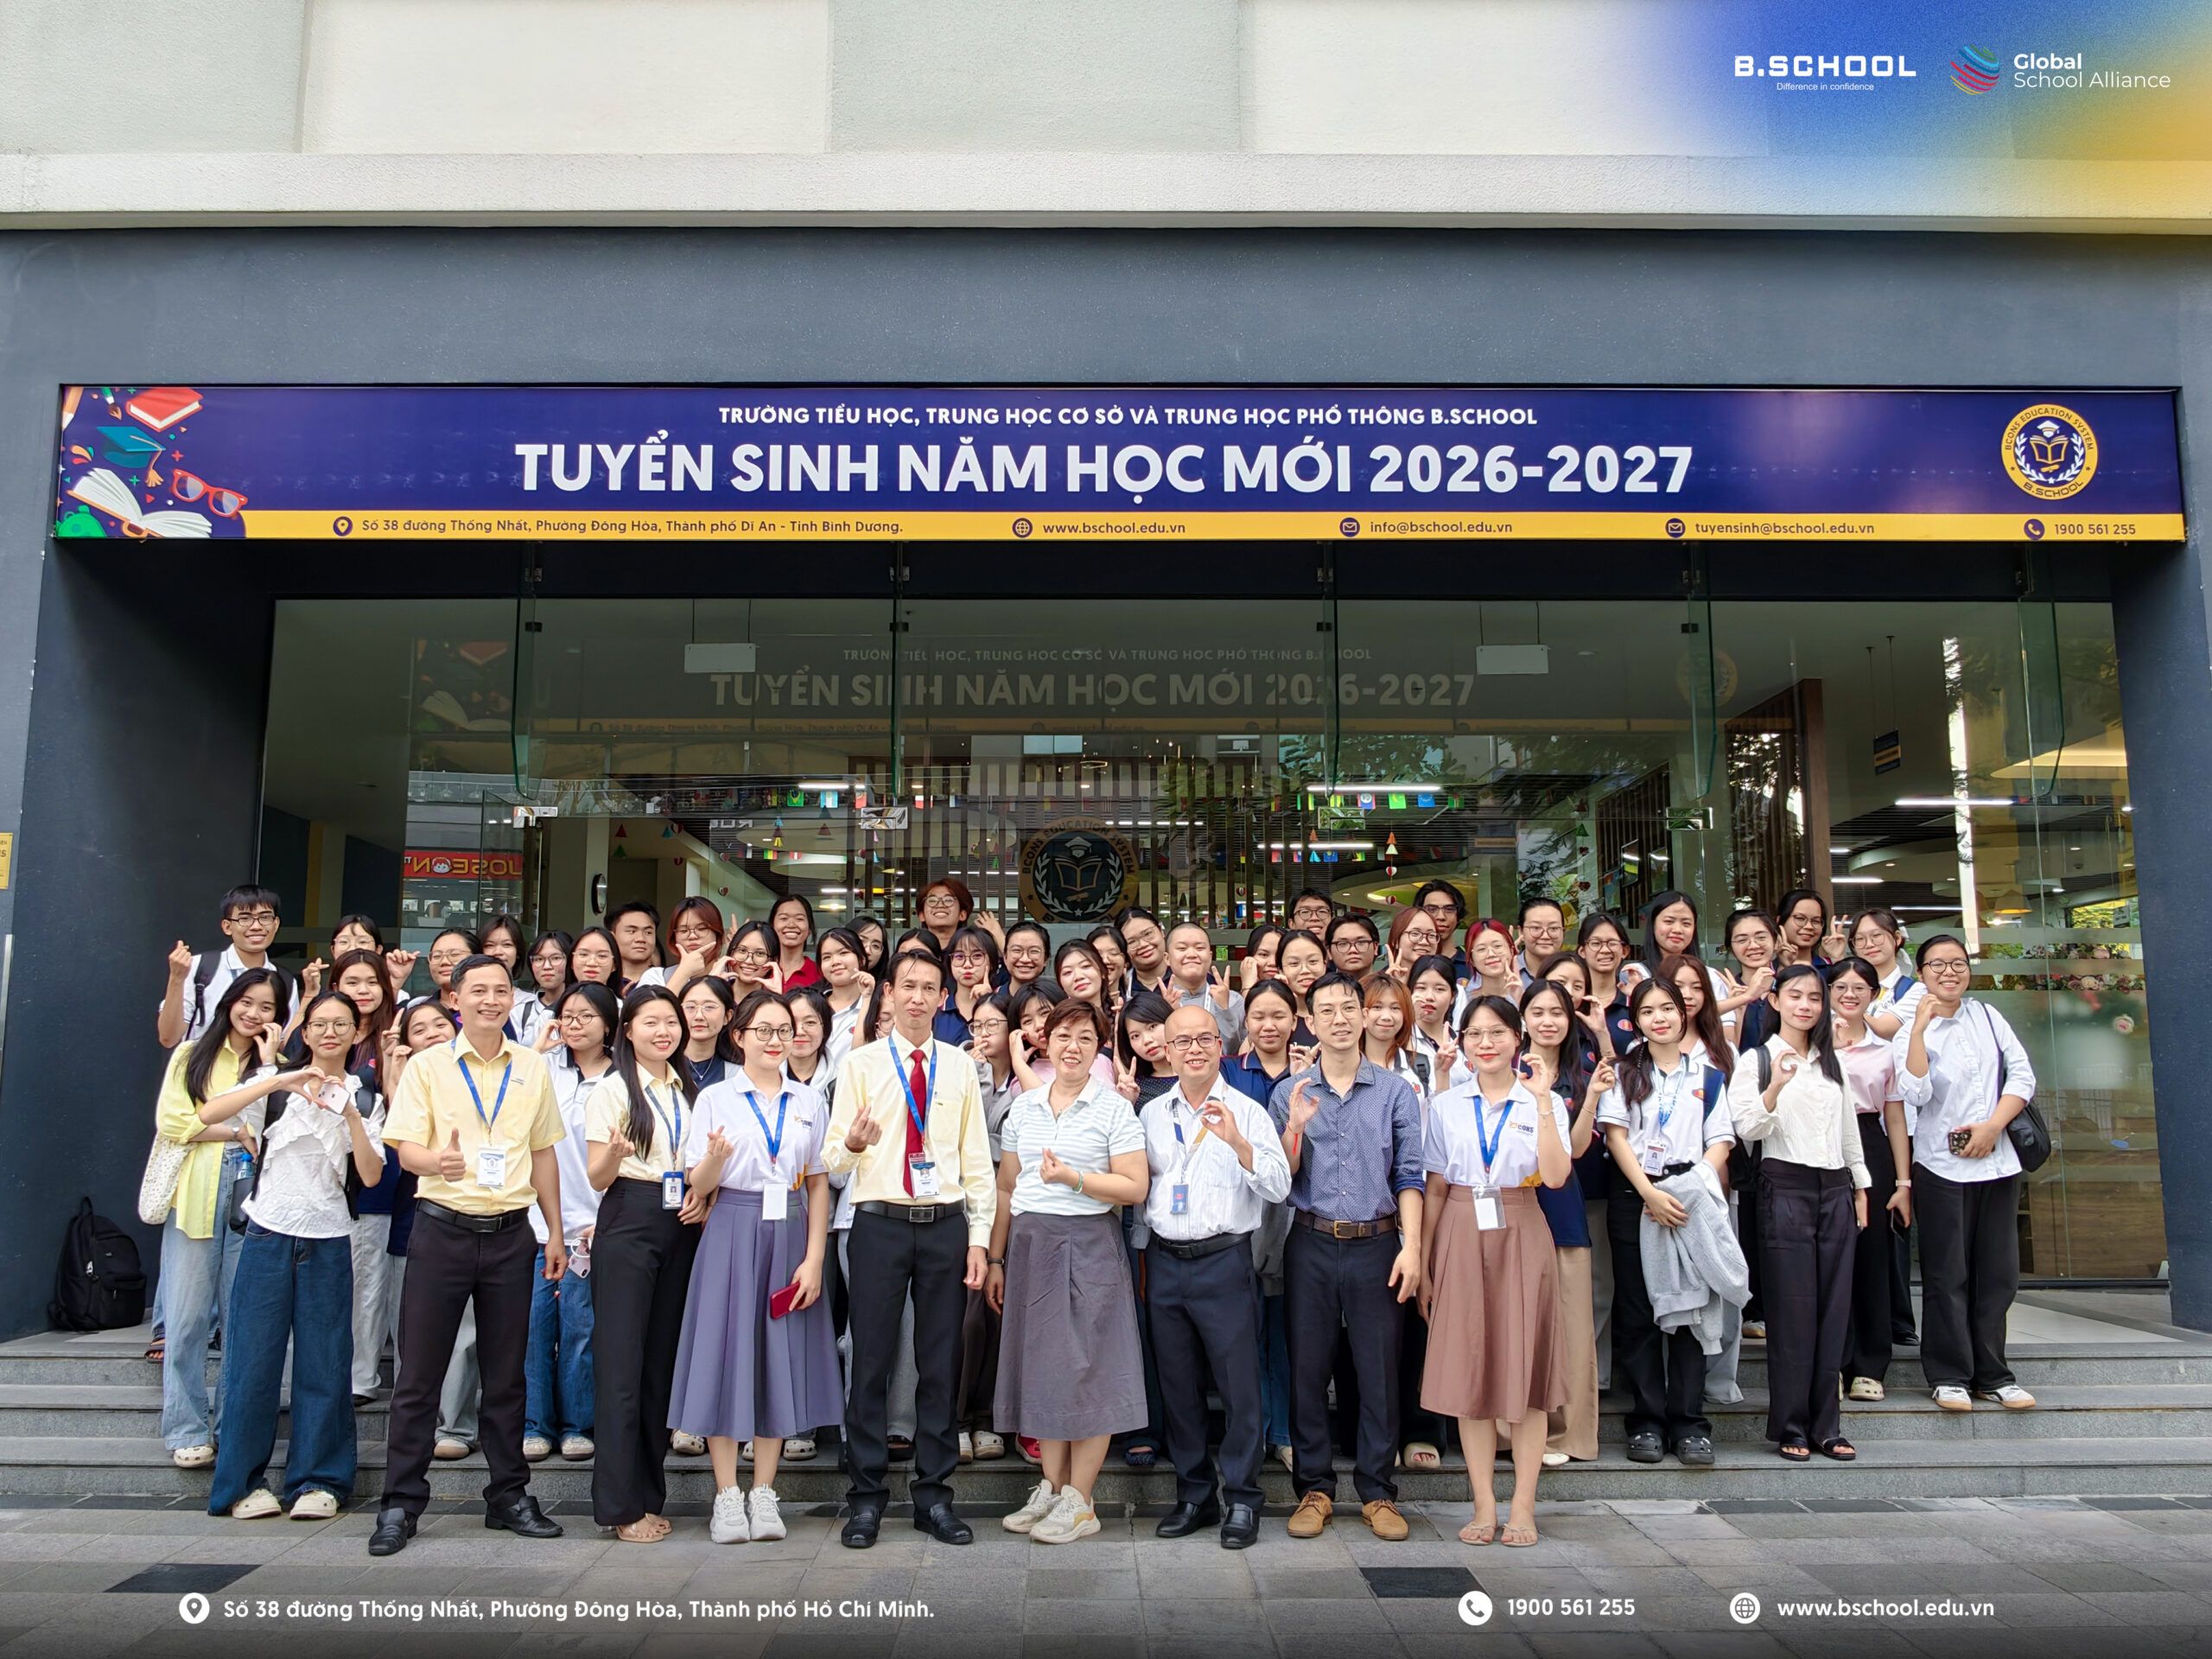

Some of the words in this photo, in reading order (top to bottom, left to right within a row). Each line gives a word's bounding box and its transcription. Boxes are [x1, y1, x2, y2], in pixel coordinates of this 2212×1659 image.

[719, 404, 810, 424] TRƯỜNG
[815, 403, 861, 424] TIỂU
[867, 408, 920, 428] HỌC,
[925, 408, 1000, 424] TRUNG
[1006, 408, 1052, 428] HỌC
[1058, 407, 1090, 424] CƠ
[1095, 404, 1123, 424] SỞ
[1129, 405, 1159, 424] VÀ
[1164, 408, 1237, 424] TRUNG
[1244, 408, 1290, 428] HỌC
[1297, 404, 1342, 425] PHỔ
[1347, 405, 1425, 425] THÔNG
[1431, 409, 1537, 425] B.SCHOOL
[2005, 421, 2021, 450] BCONS
[2019, 408, 2073, 423] EDUCATION
[2073, 419, 2094, 450] SYSTEM
[515, 429, 714, 492] TUYỂN
[730, 443, 879, 493] SINH
[898, 437, 1046, 493] NĂM
[1067, 443, 1205, 505] HỌC
[1223, 435, 1351, 493] MỚI
[1369, 443, 1693, 493] 2026-2027
[2023, 480, 2084, 499] B.SCHOOL
[362, 520, 378, 531] Số
[383, 520, 398, 531] 38
[403, 520, 446, 533] đường
[450, 520, 493, 533] Thống
[536, 520, 586, 533] Phường
[631, 521, 662, 532] Hòa,
[666, 521, 706, 531] Thành
[710, 521, 737, 534] phố
[759, 521, 776, 531] An
[855, 521, 904, 535] Dương.
[1042, 522, 1186, 534] www.bschool.edu.vn
[1370, 521, 1513, 534] info@bschool.edu.vn
[1695, 522, 1875, 536] tuyensinh@bschool.edu.vn
[2055, 524, 2084, 535] 1900
[2088, 524, 2108, 535] 561
[2113, 524, 2136, 535] 255
[710, 664, 840, 707] TUYỂN
[956, 669, 1055, 706] NĂM
[1067, 674, 1157, 714] HỌC
[1168, 667, 1253, 706] MỚI
